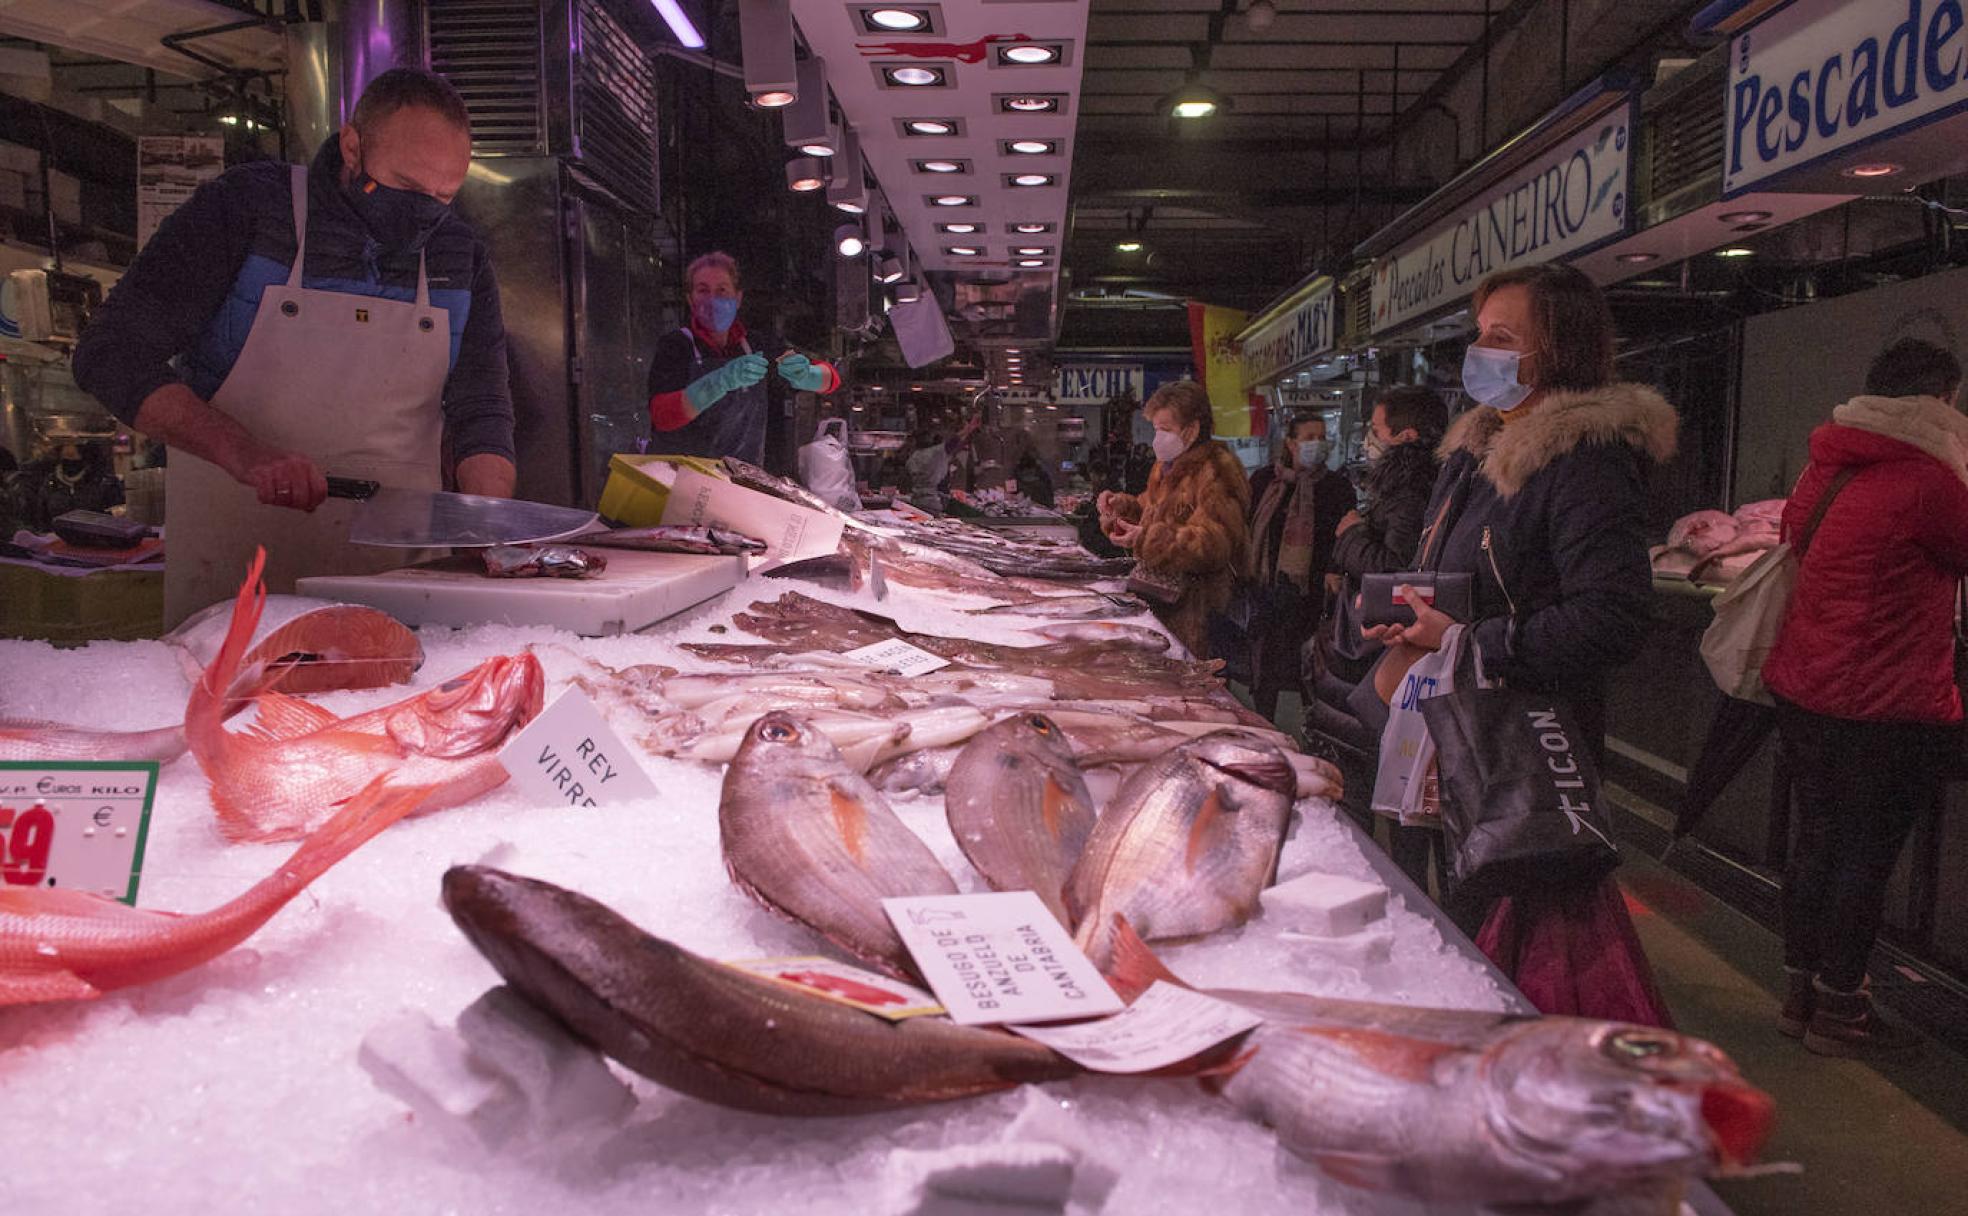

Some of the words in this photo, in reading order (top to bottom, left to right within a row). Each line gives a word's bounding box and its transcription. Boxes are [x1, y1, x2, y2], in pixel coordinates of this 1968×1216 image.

[1730, 0, 1968, 175] Pescade
[1451, 149, 1591, 285] CANEIRO
[576, 737, 617, 784] REY
[92, 786, 140, 794] KILO
[931, 929, 958, 947] DE
[965, 934, 1022, 996] ANZUELO
[1007, 953, 1035, 973] DE
[1017, 925, 1086, 1000] CANTABRIA
[947, 952, 999, 1009] BESUGO
